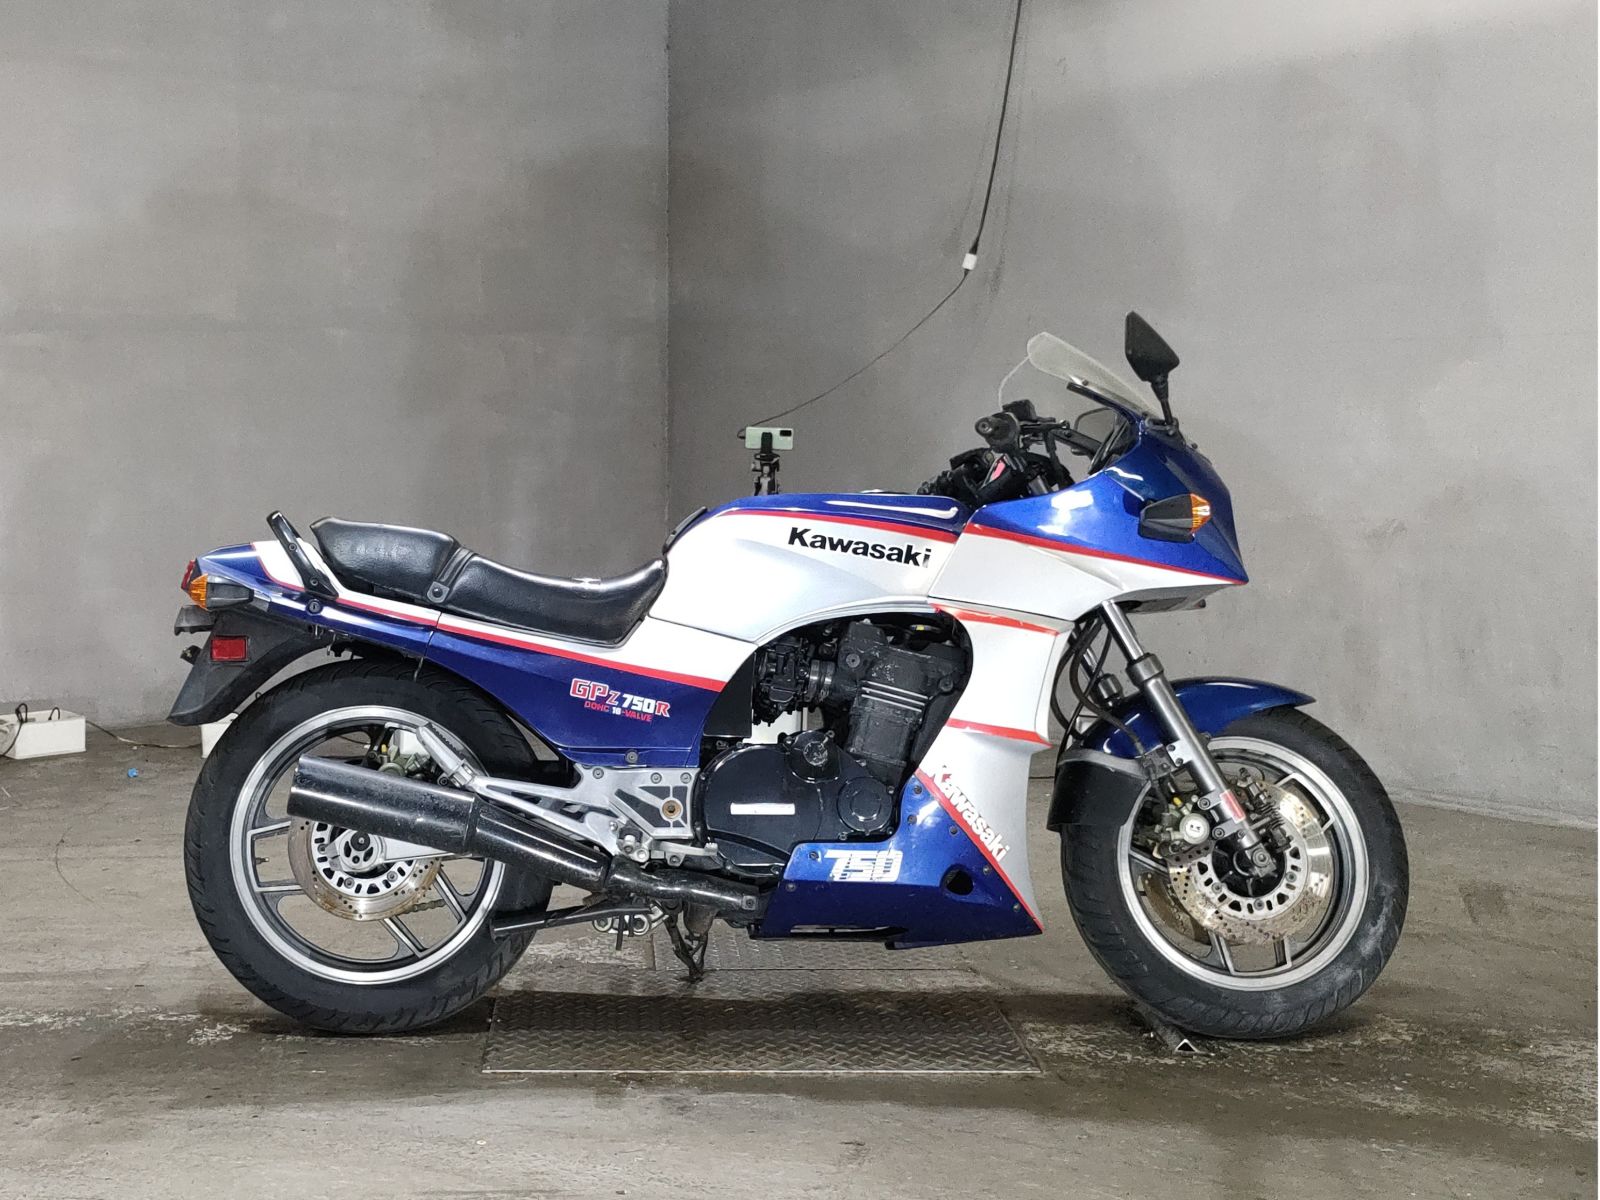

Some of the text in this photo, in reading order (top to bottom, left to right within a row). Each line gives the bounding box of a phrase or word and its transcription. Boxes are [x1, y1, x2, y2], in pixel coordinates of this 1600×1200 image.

[788, 527, 932, 568] Kawasaki
[584, 701, 610, 713] DOHC
[824, 849, 903, 882] 750
